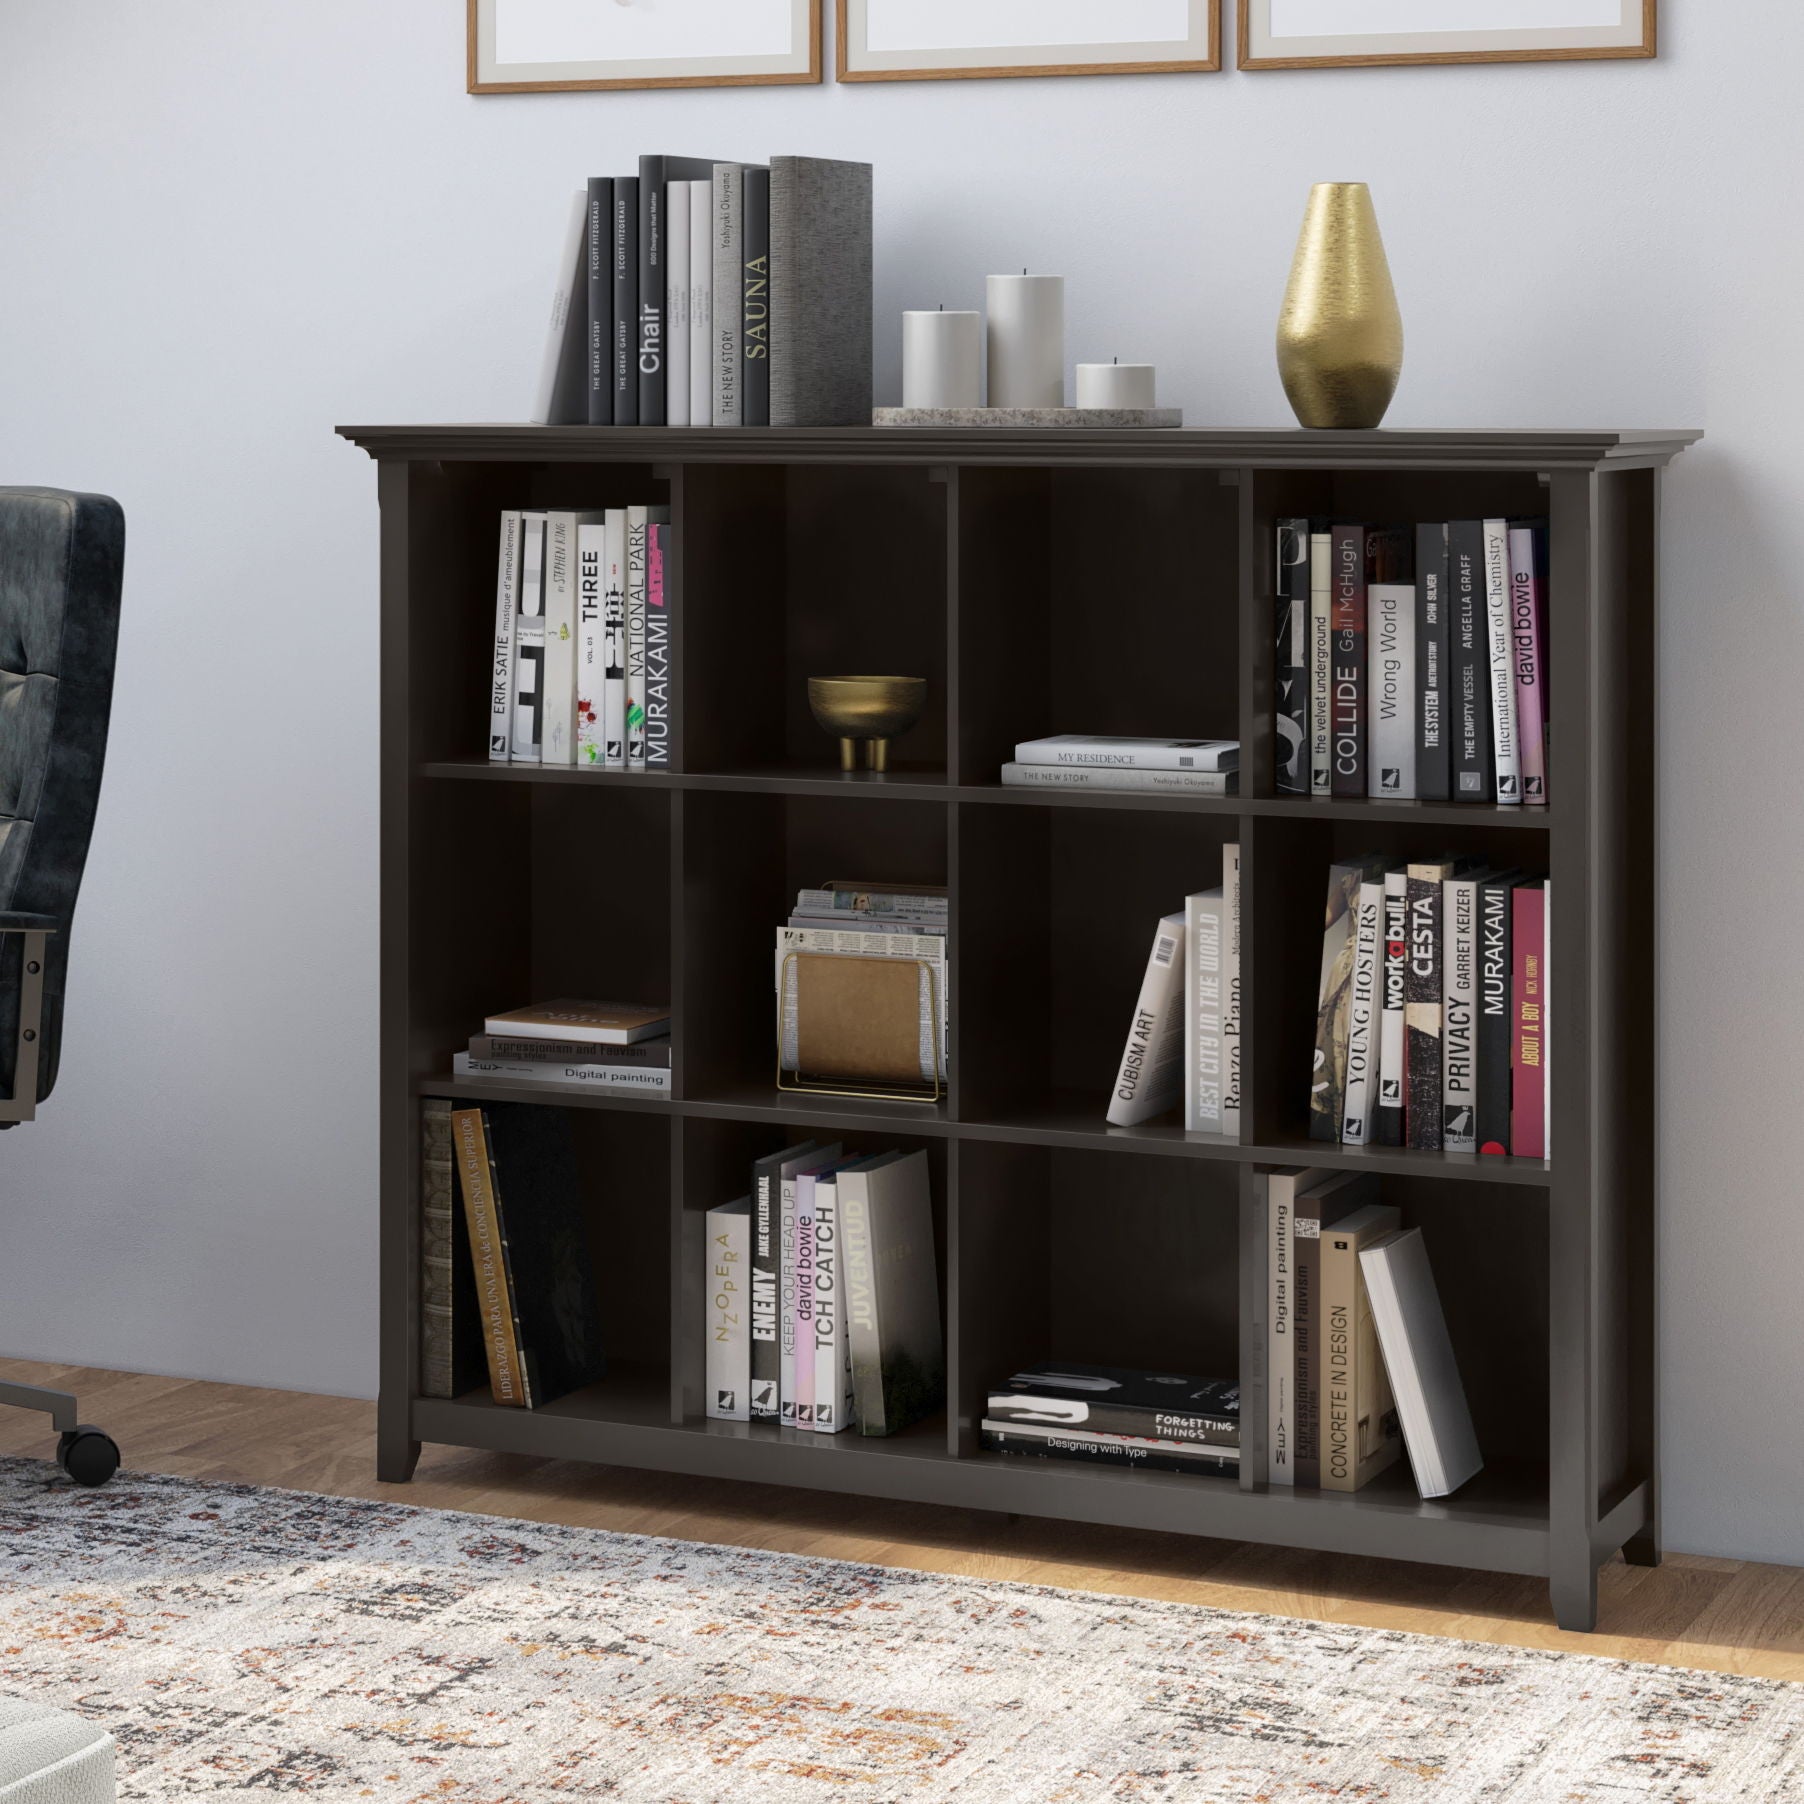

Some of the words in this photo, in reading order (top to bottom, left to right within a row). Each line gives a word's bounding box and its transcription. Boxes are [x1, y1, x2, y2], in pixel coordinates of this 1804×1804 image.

[722, 173, 732, 210] Okuyama
[650, 228, 658, 252] Designs
[722, 213, 732, 249] Yoshiyuki
[746, 256, 766, 359] SAUNA
[640, 304, 660, 374] Chair
[722, 330, 734, 364] STORY
[722, 366, 734, 392] NEW
[722, 394, 734, 414] THE
[506, 518, 515, 590] d'ameublement
[556, 523, 566, 544] KING
[630, 524, 644, 571] PARK
[554, 546, 566, 584] STEPHEN
[1340, 540, 1356, 612] McHugh
[1460, 554, 1472, 592] GRAFF
[1488, 534, 1504, 608] Chemistry
[582, 551, 598, 622] THREE
[1427, 574, 1437, 600] SILVER
[1511, 572, 1532, 630] bowie
[503, 591, 512, 631] musique
[630, 578, 644, 677] NATIONAL
[1380, 600, 1396, 652] World
[1427, 603, 1437, 624] JOHN
[1462, 596, 1472, 648] ANGELLA
[1490, 611, 1504, 627] of
[496, 636, 509, 677] SATIE
[587, 637, 593, 648] 03
[1315, 617, 1328, 694] underground
[1340, 620, 1354, 652] Gail
[1493, 632, 1506, 663] Year
[1516, 636, 1534, 686] david
[494, 682, 507, 714] ERIK
[648, 614, 668, 762] MURAKAMI
[1380, 660, 1400, 720] Wrong
[1464, 664, 1474, 701] VESSEL
[1315, 696, 1326, 731] velvet
[1337, 667, 1356, 774] COLLIDE
[1425, 691, 1438, 729] SYSTEM
[1464, 703, 1474, 738] EMPTY
[1494, 669, 1511, 758] International
[1058, 752, 1074, 762] MY
[1077, 753, 1136, 765] RESIDENCE
[1315, 735, 1326, 754] the
[1425, 731, 1438, 748] THE
[1465, 741, 1475, 760] THE
[1042, 773, 1060, 781] NEW
[1063, 774, 1089, 782] STORY
[1154, 776, 1182, 786] Yoshiyuki
[1184, 778, 1215, 787] Okuyama
[1457, 888, 1470, 934] KEIZER
[1200, 913, 1220, 972] WORLD
[1355, 904, 1377, 1004] HOSTERS
[1413, 896, 1434, 976] CESTA
[1484, 889, 1504, 1015] MURAKAMI
[1457, 937, 1470, 990] GARRET
[1526, 955, 1537, 978] HORNBY
[1200, 975, 1220, 1008] THE
[1526, 979, 1537, 994] NICK
[1224, 978, 1240, 1037] Piano
[1522, 1002, 1539, 1021] BOY
[491, 1039, 573, 1056] Expressionism
[576, 1044, 596, 1056] and
[1118, 1045, 1146, 1101] CUBISM
[1136, 1012, 1156, 1044] ART
[1200, 1038, 1220, 1076] CITY
[1350, 1008, 1370, 1086] YOUNG
[1448, 997, 1470, 1092] PRIVACY
[1522, 1036, 1539, 1066] ABOUT
[565, 1068, 606, 1080] Digital
[611, 1072, 664, 1086] painting
[1224, 1047, 1240, 1110] Renzo
[1200, 1080, 1220, 1120] BEST
[462, 1117, 478, 1169] SUPERIOR
[470, 1172, 488, 1240] CONCIENCIA
[758, 1176, 770, 1234] GYLLENHAAL
[784, 1188, 794, 1212] UP
[758, 1236, 770, 1258] JAKE
[784, 1215, 794, 1261] HEAD
[796, 1216, 812, 1269] bowie
[816, 1207, 834, 1292] CATCH
[1276, 1205, 1288, 1273] painting
[846, 1202, 872, 1330] JUVENTUD
[486, 1279, 500, 1304] UNA
[752, 1267, 776, 1342] ENEMY
[784, 1264, 794, 1315] YOUR
[797, 1272, 812, 1321] david
[1276, 1280, 1288, 1334] Digital
[1295, 1266, 1308, 1322] Fauvism
[492, 1306, 504, 1336] PARA
[784, 1316, 794, 1356] KEEP
[816, 1300, 834, 1350] TCH
[1295, 1328, 1308, 1352] and
[1331, 1306, 1347, 1366] DESIGN
[498, 1336, 513, 1400] LIDERAZGO
[1331, 1370, 1347, 1386] IN
[1156, 1414, 1236, 1432] FORGETTING
[1294, 1358, 1308, 1459] Expressionism
[1048, 1436, 1098, 1454] Designing
[1100, 1442, 1122, 1454] with
[1124, 1446, 1148, 1459] Type
[1156, 1425, 1206, 1440] THINGS
[1331, 1390, 1347, 1479] CONCRETE
